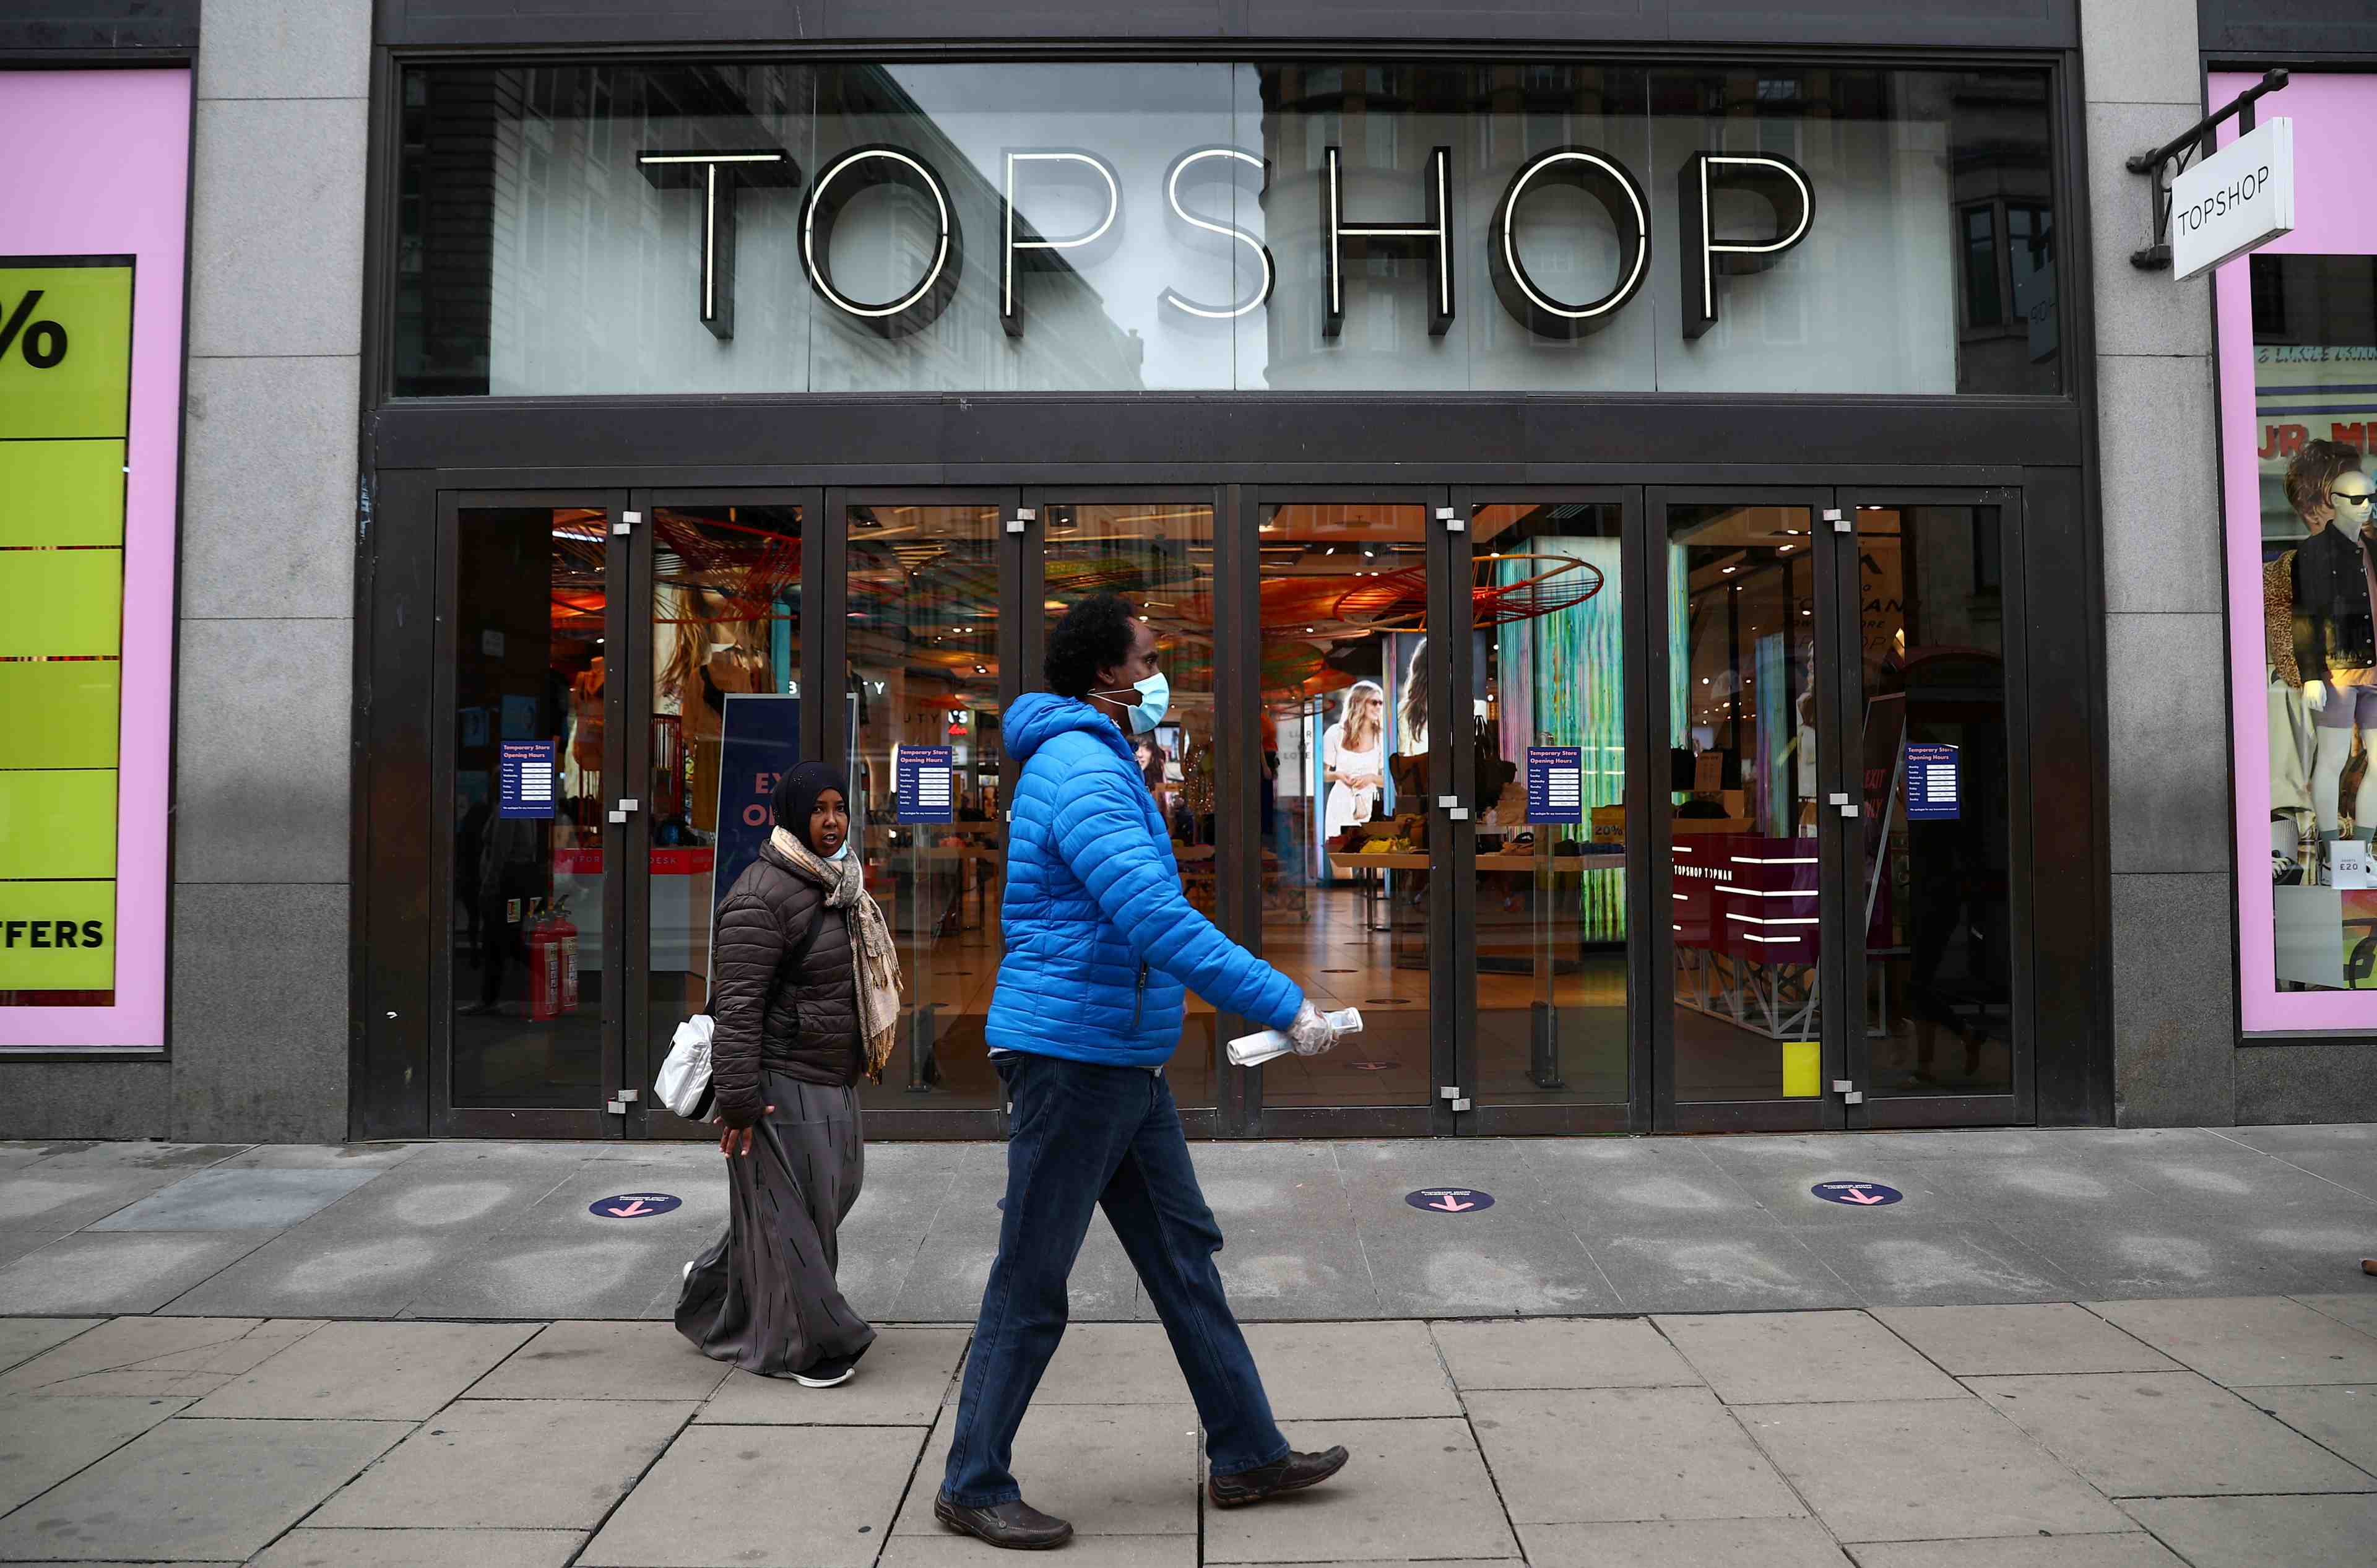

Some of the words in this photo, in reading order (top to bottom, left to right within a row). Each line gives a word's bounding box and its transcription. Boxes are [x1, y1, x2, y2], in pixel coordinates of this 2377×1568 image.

[2177, 165, 2269, 236] TOPSHOP
[636, 144, 1816, 337] TOPSHOP
[1674, 865, 1702, 878] TOPSHOP
[0, 920, 103, 948] FERS
